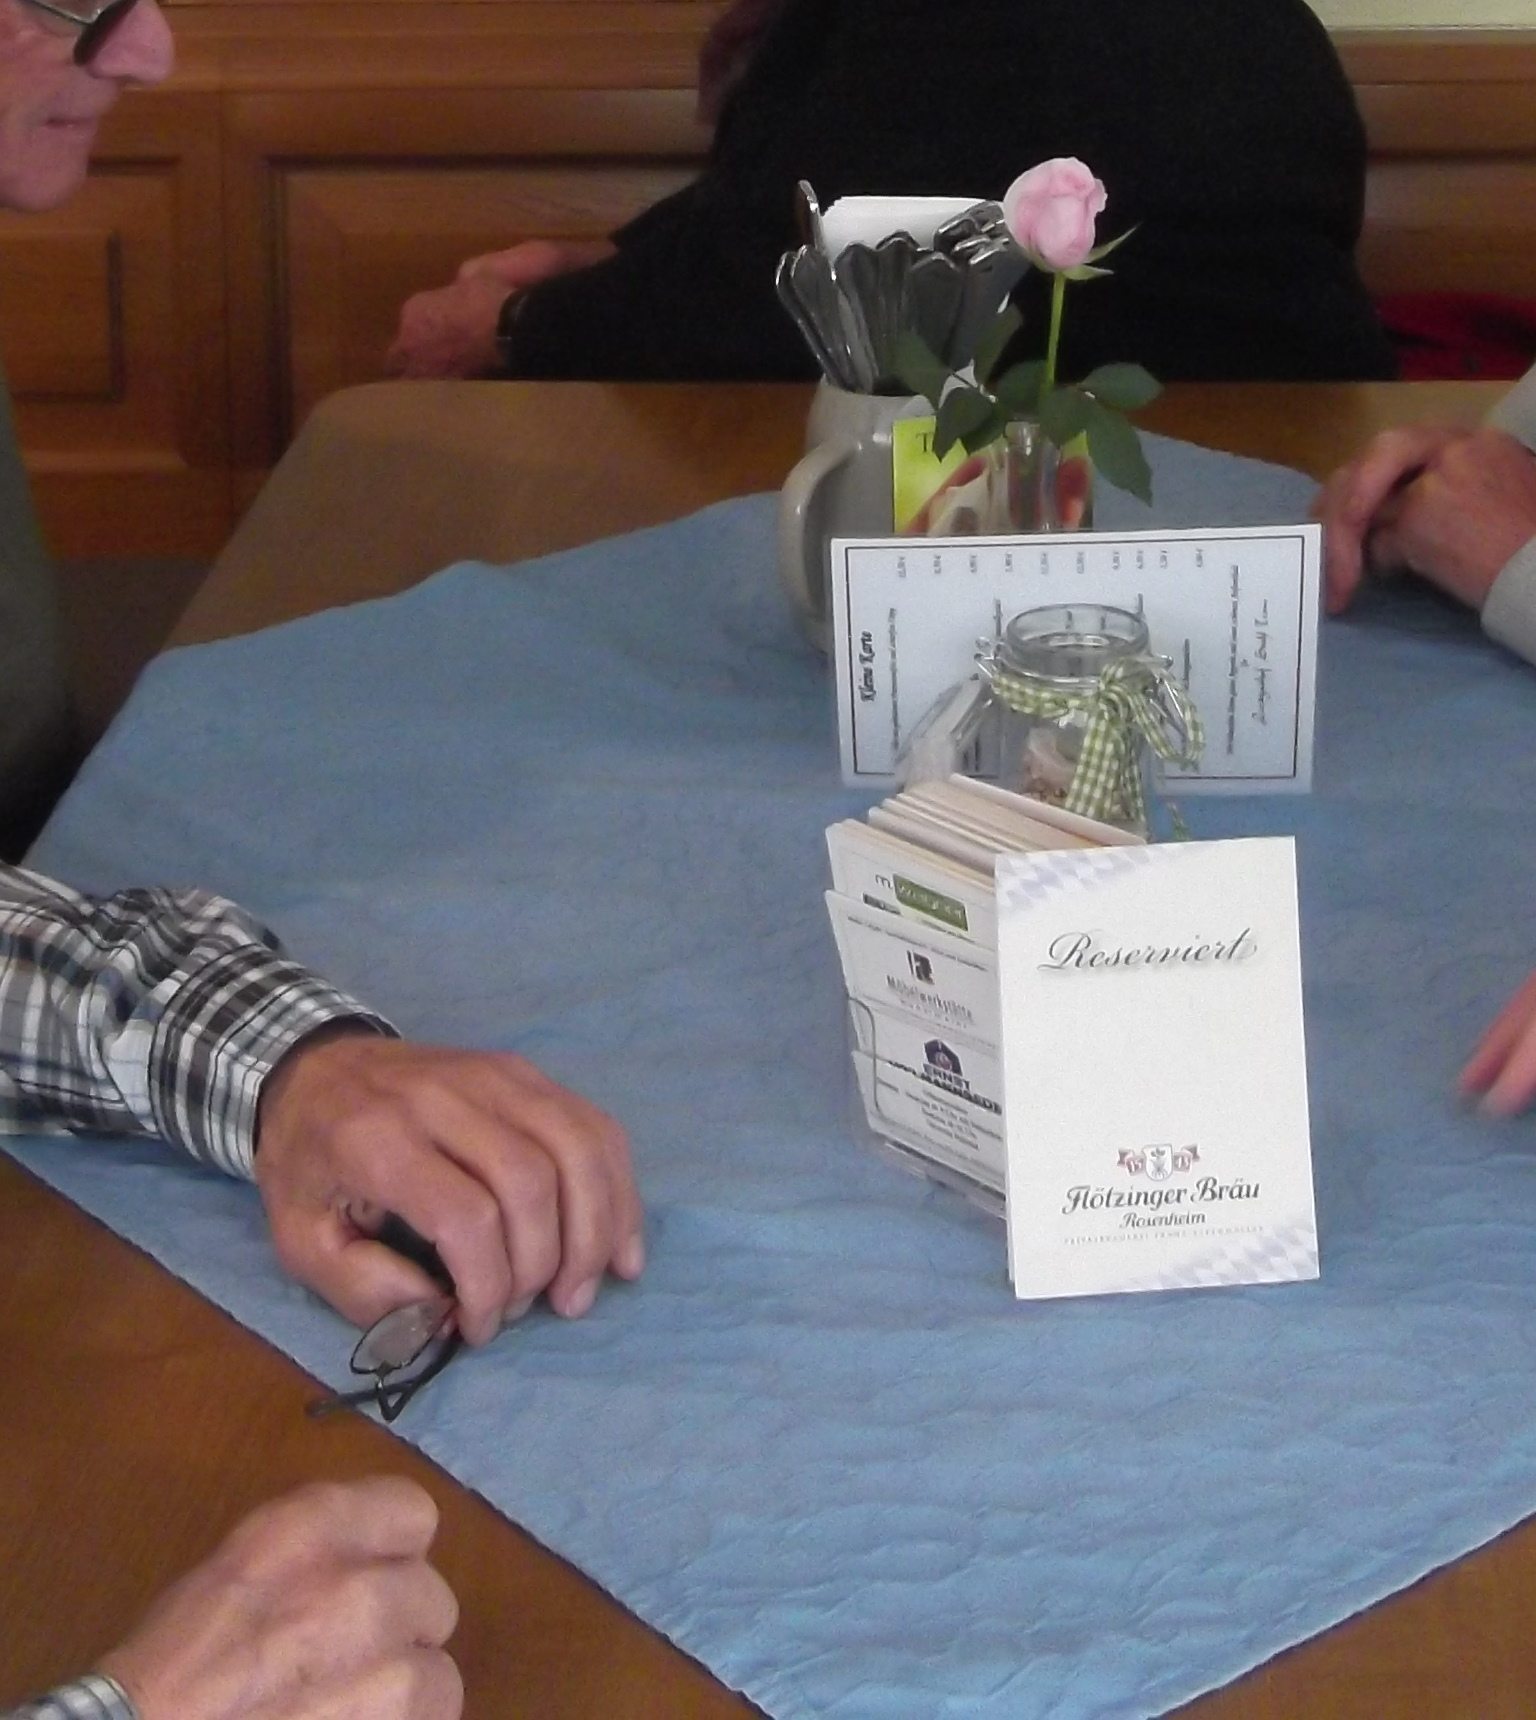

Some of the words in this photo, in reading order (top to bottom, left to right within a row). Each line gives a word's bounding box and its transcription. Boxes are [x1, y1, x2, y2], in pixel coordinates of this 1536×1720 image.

[1036, 927, 1258, 971] Reserviert
[1061, 1184, 1189, 1215] Flötzinger
[1190, 1176, 1261, 1203] Bräu
[1119, 1211, 1206, 1229] Rosenheim
